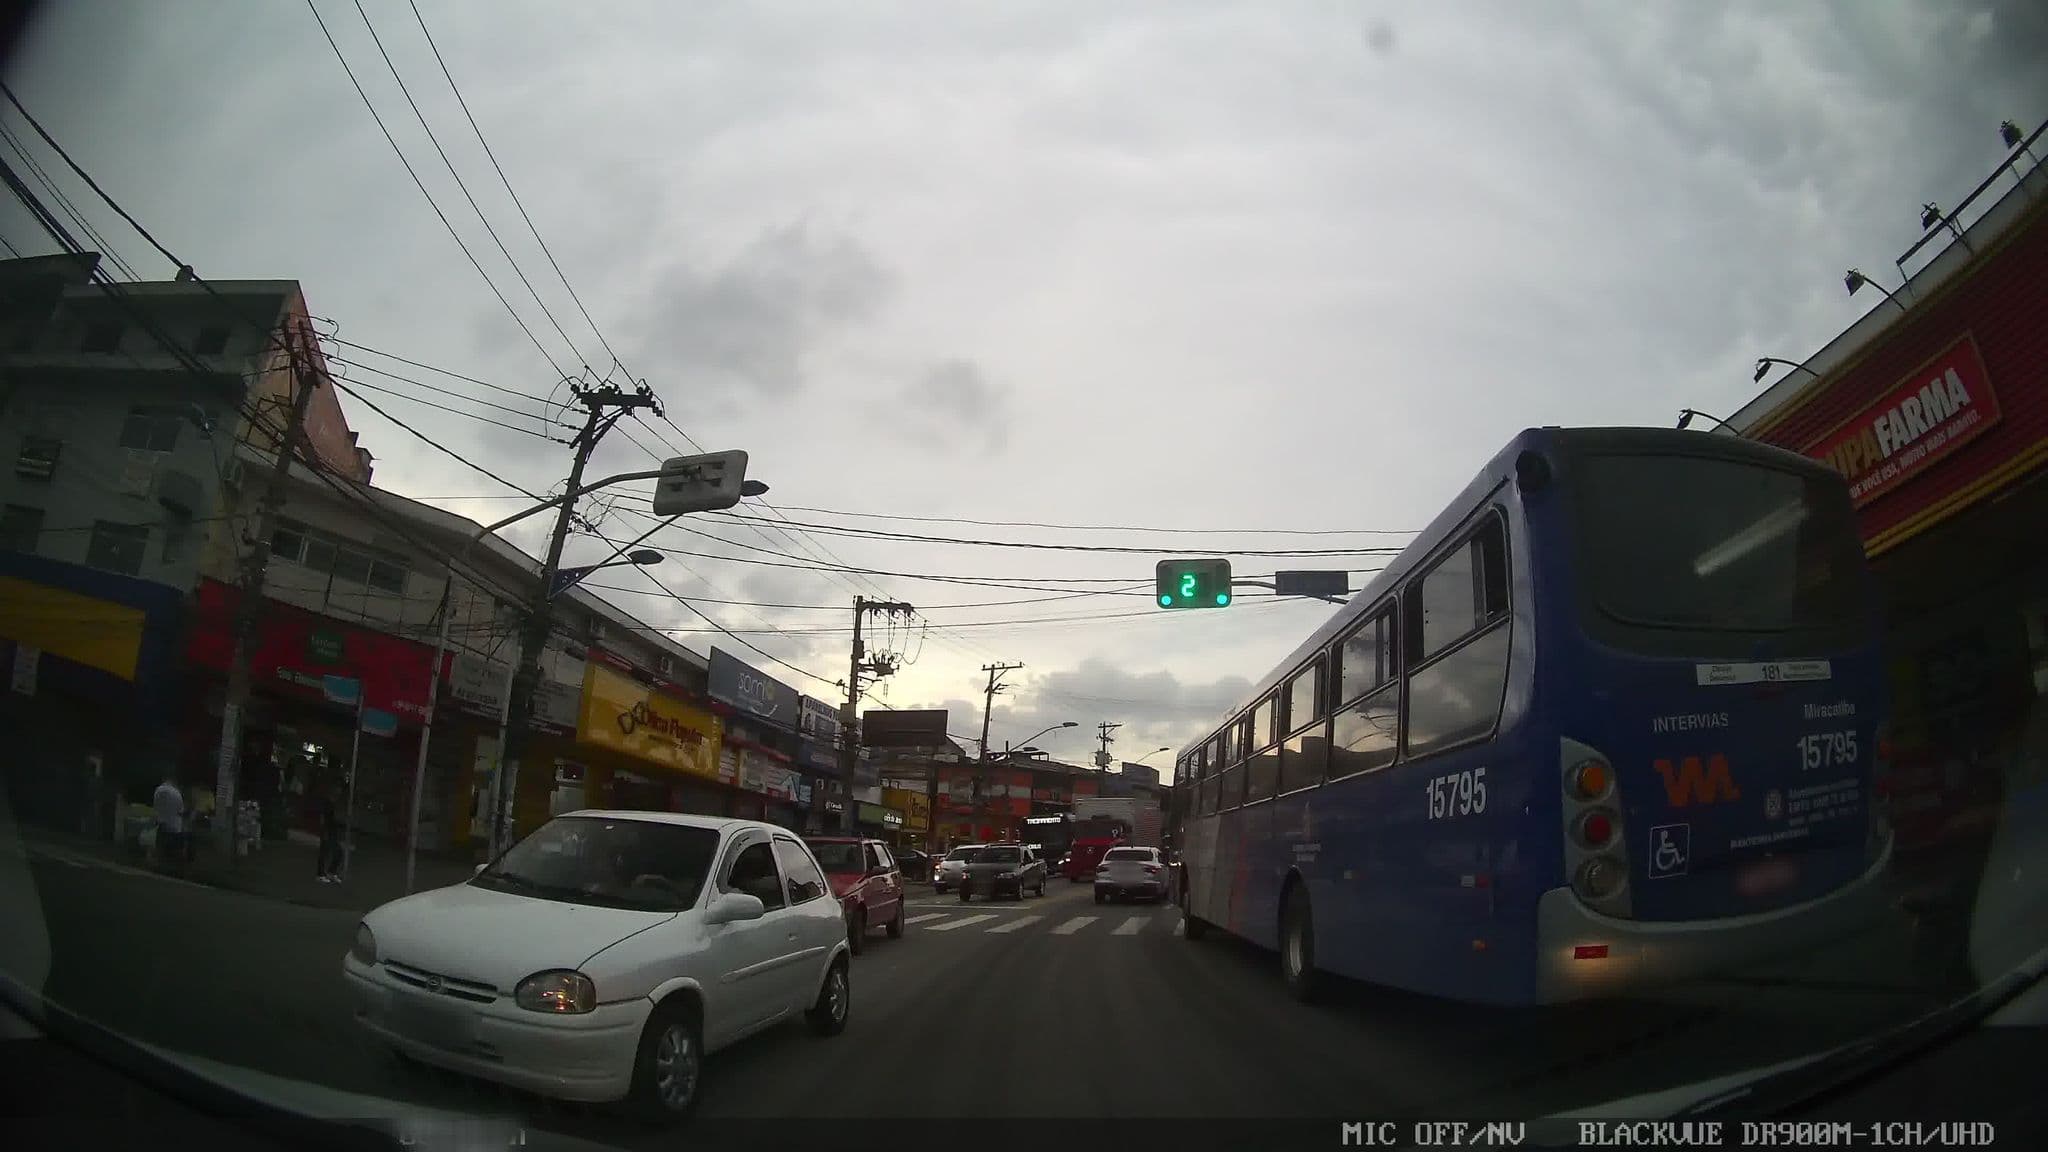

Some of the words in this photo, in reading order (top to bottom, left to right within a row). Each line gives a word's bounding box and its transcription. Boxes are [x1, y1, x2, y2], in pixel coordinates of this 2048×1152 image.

[1180, 573, 1196, 598] 2
[1761, 664, 1781, 681] 181
[1652, 711, 1729, 734] INTERVIAS
[1796, 730, 1857, 770] 15795
[1426, 767, 1487, 820] 15795
